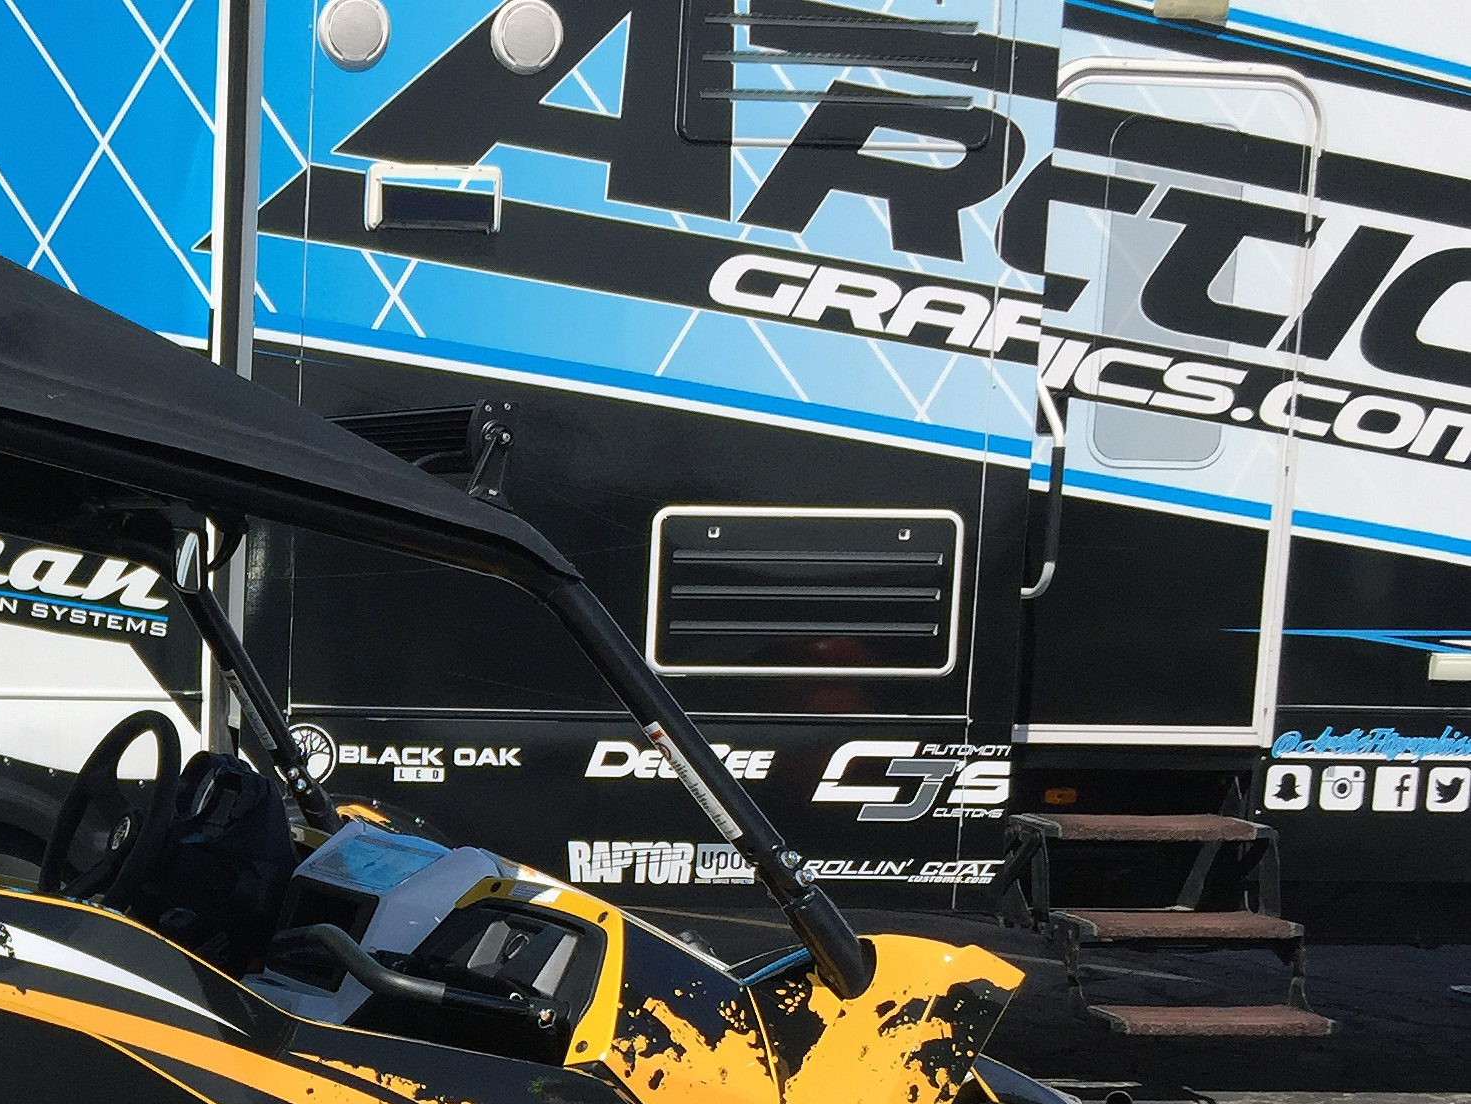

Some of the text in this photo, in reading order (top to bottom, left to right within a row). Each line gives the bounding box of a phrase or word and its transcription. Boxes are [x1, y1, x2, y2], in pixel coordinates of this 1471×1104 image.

[30, 602, 169, 638] SYSTEMS
[338, 745, 522, 767] BLACK OAK
[397, 768, 441, 781] LED
[932, 807, 1005, 819] CUSTOMS
[567, 841, 695, 884] RAPTOR
[919, 859, 1006, 877] COAL
